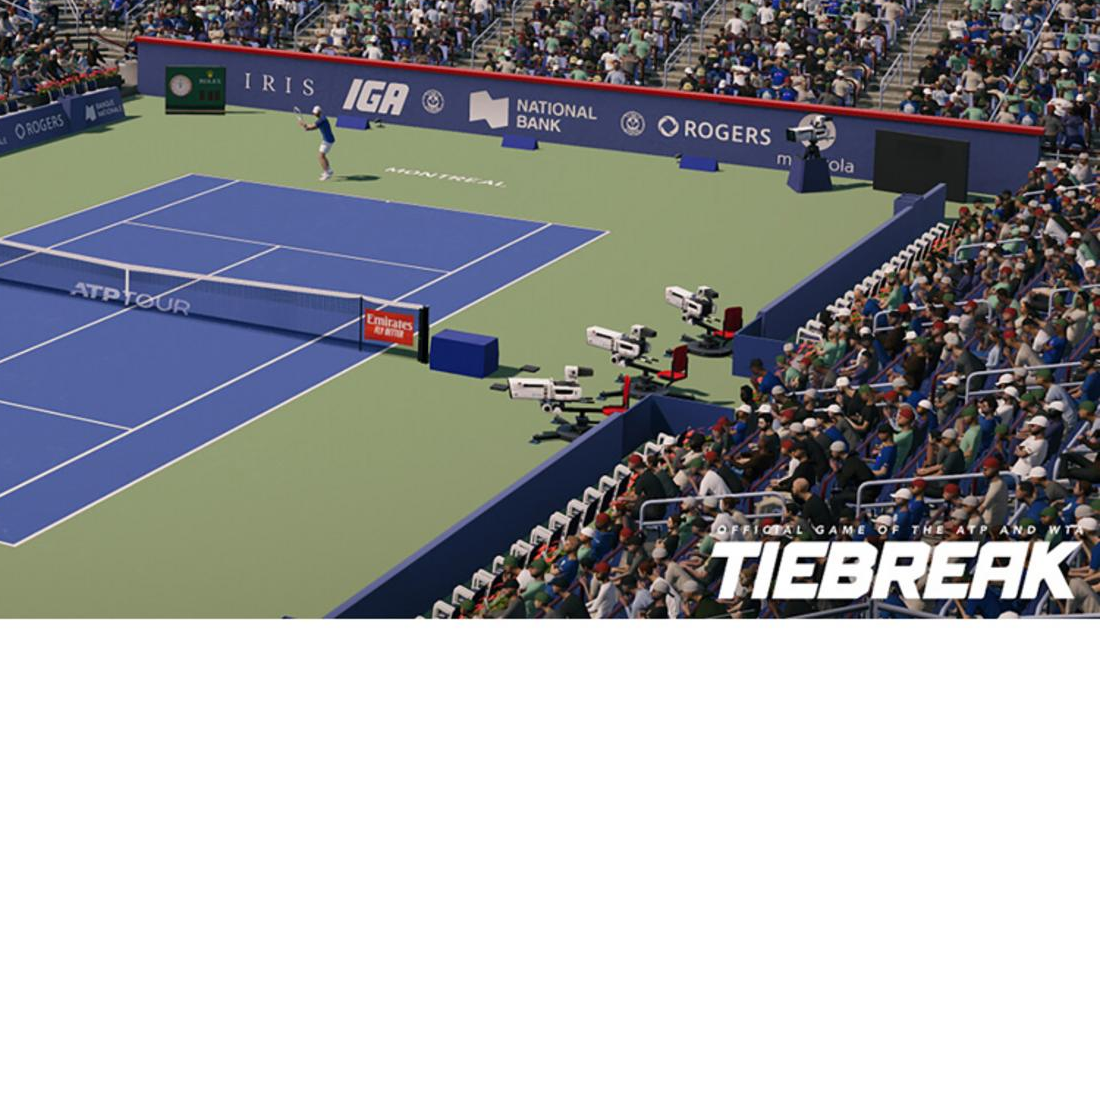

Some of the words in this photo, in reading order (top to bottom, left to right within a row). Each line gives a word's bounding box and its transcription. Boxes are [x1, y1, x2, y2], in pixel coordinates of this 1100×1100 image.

[244, 72, 315, 97] IRIS
[342, 78, 409, 116] IGA
[516, 98, 598, 121] NATIONAL
[25, 114, 65, 137] ROGERS
[516, 114, 561, 133] BANK
[684, 119, 772, 146] ROGERS
[777, 153, 855, 174] mola
[366, 313, 413, 331] Emirates
